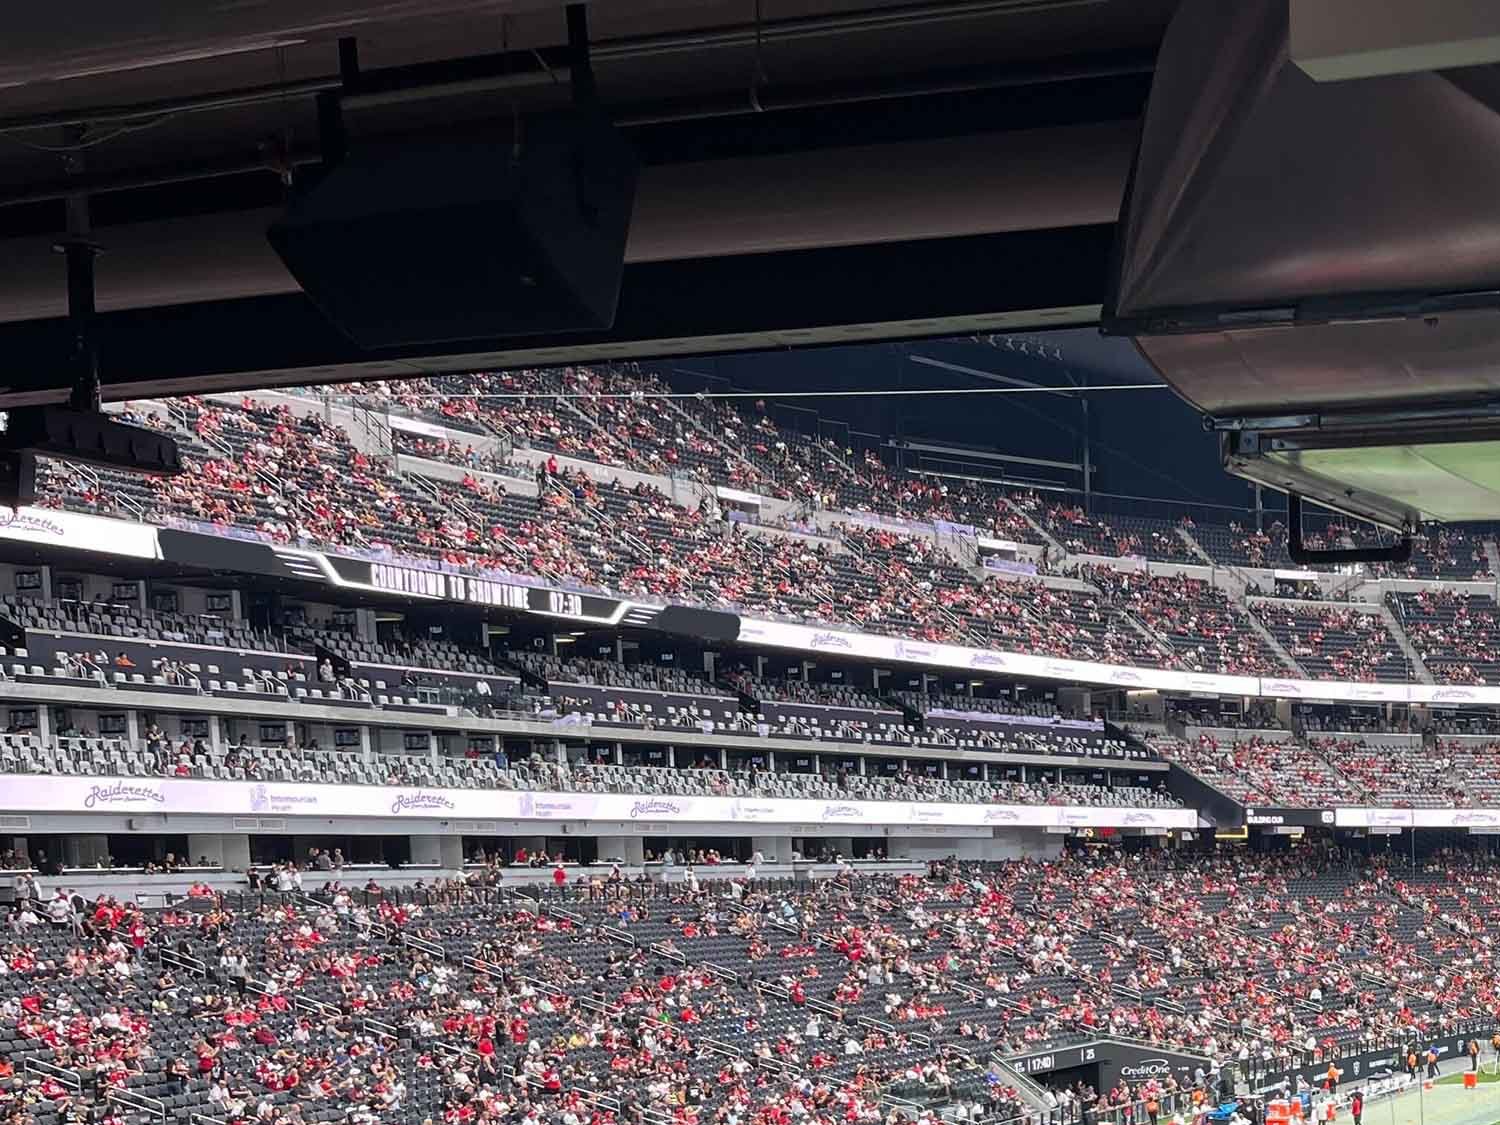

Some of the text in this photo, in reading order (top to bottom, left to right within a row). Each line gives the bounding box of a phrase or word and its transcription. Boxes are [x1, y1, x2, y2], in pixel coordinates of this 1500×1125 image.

[371, 563, 583, 616] COUNTDOWN TO SHOWTIME 07:30
[84, 781, 165, 807] Raiderettes
[391, 790, 455, 814] Raiderettes
